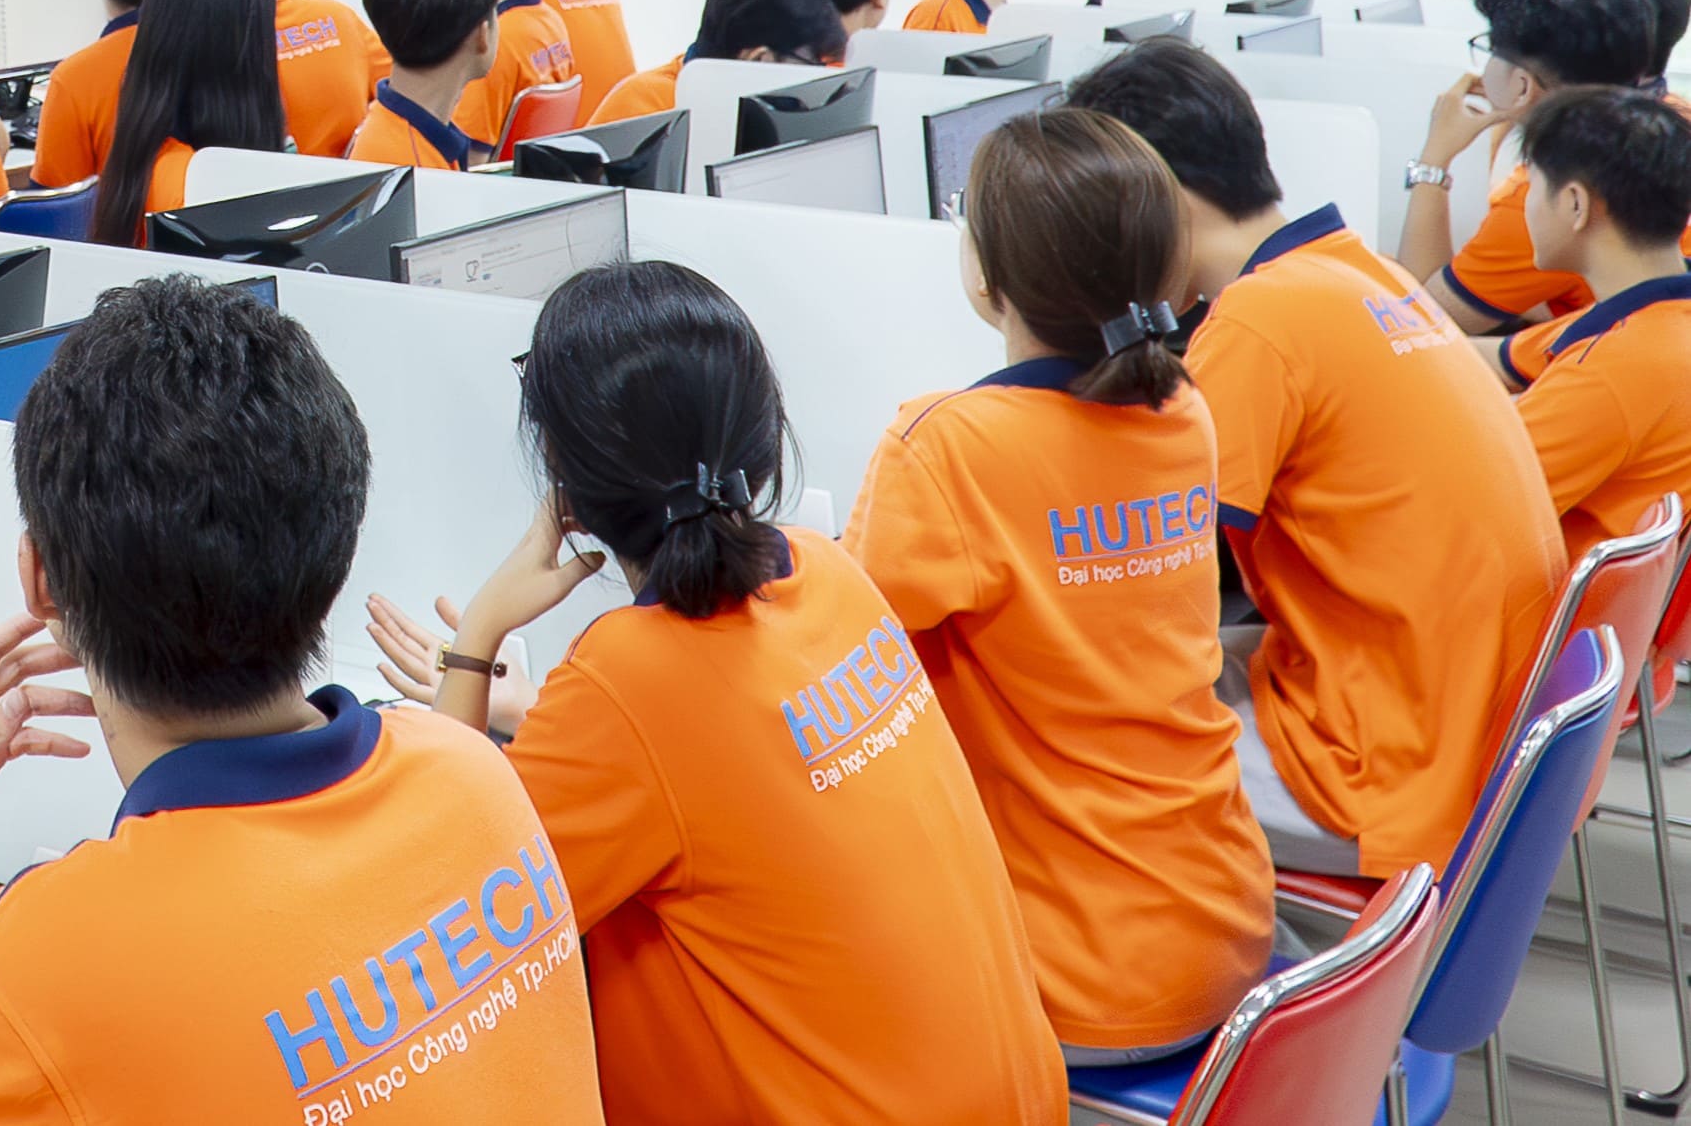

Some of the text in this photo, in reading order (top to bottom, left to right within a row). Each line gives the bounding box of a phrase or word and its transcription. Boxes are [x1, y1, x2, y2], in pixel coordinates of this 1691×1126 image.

[276, 16, 338, 50] TECH
[810, 761, 843, 793] Đại
[838, 749, 868, 777] học
[862, 726, 898, 758] Công
[263, 834, 568, 1091] HUTECH
[304, 1089, 354, 1126] Đại
[355, 1065, 407, 1107] học
[408, 1022, 469, 1077] Công
[468, 977, 518, 1035] nghệ
